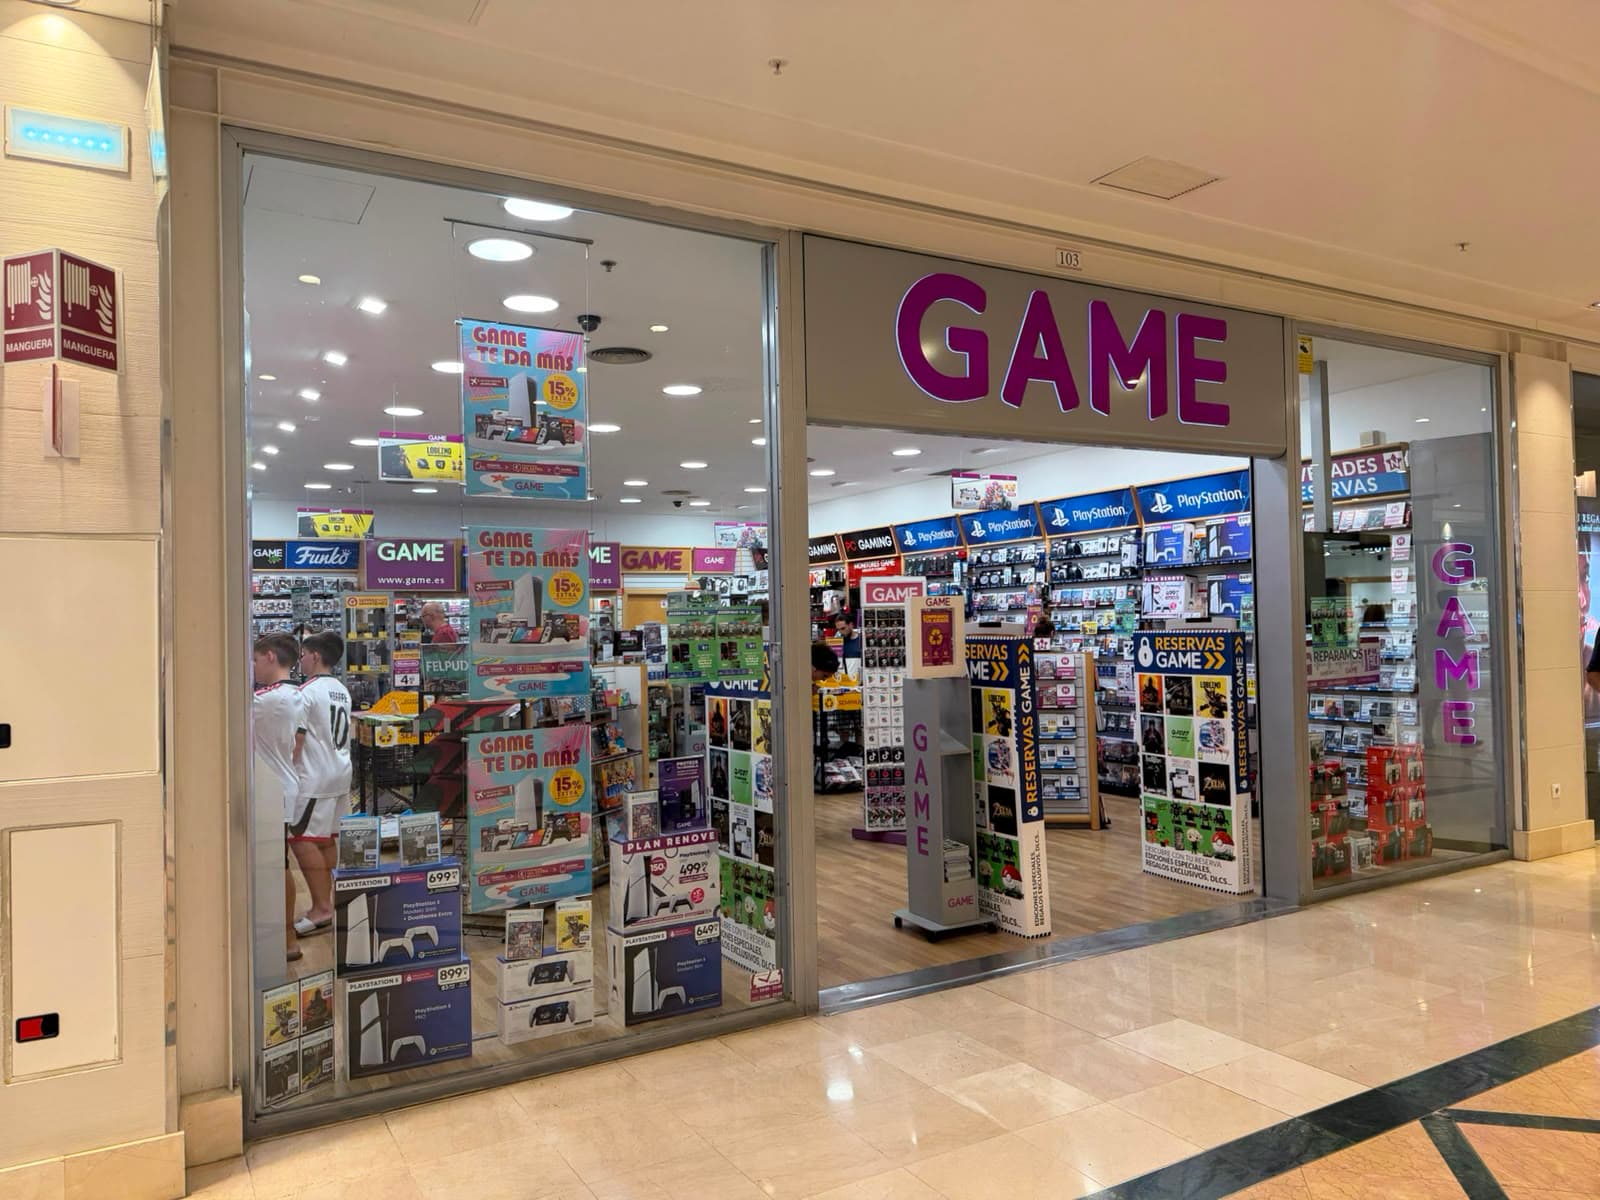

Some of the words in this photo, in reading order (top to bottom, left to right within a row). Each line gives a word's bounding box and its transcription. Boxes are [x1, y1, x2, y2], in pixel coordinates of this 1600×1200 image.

[1059, 252, 1079, 268] 103
[473, 326, 527, 348] GAME
[6, 338, 53, 353] MANGUERA
[63, 339, 115, 361] MANGUERA
[896, 272, 1230, 428] GAME
[476, 346, 498, 364] TE
[504, 349, 532, 367] DA
[536, 352, 573, 371] MÁS
[548, 381, 575, 397] 15%
[514, 481, 544, 491] GAME
[1177, 488, 1246, 509] PlayStation
[1072, 504, 1128, 523] PlayStation
[988, 518, 1033, 534] PlayStation
[479, 531, 533, 548] GAME
[845, 540, 857, 551] PC
[858, 535, 892, 551] GAMING
[918, 529, 954, 543] PlayStation
[253, 548, 283, 558] GAME
[294, 545, 350, 565] Funko
[377, 542, 444, 562] GAME
[482, 551, 504, 567] TE
[510, 551, 537, 567] DA
[542, 548, 580, 568] MÁS
[588, 546, 612, 564] ME
[621, 550, 683, 571] GAME
[378, 576, 445, 585] www.game.es
[554, 578, 580, 593] 15%
[872, 586, 918, 602] GAME
[926, 597, 951, 606] GAME
[1155, 636, 1225, 651] RESERVAS
[1432, 542, 1481, 745] GAME
[964, 644, 1008, 660] SERVAS
[1155, 651, 1202, 669] GAME
[1313, 648, 1363, 662] REPARAMOS
[964, 660, 990, 680] AME
[1235, 656, 1246, 698] GAME
[518, 679, 548, 690] GAME
[1020, 666, 1033, 713] GAME
[330, 705, 349, 751] 10
[479, 734, 534, 754] GAME
[1236, 700, 1247, 777] RESERVAS
[483, 756, 505, 774] TE
[510, 753, 538, 770] DA
[543, 746, 580, 767] MÁS
[1022, 715, 1038, 804] RESERVAS
[554, 777, 581, 791] 15%
[912, 723, 930, 857] GAME
[627, 840, 661, 852] PLAN
[667, 832, 715, 846] RENOVE
[1145, 852, 1174, 865] EDICIONES
[1145, 860, 1170, 872] REGALOS
[680, 862, 701, 875] 499
[338, 880, 382, 889] PLAYSTATION
[429, 871, 452, 883] 699
[520, 885, 550, 898] GAME
[947, 895, 974, 908] GAME
[696, 925, 713, 936] 649
[625, 934, 661, 945] PLAYSTATION
[440, 967, 462, 980] 899
[350, 980, 393, 990] PLAYSTATION
